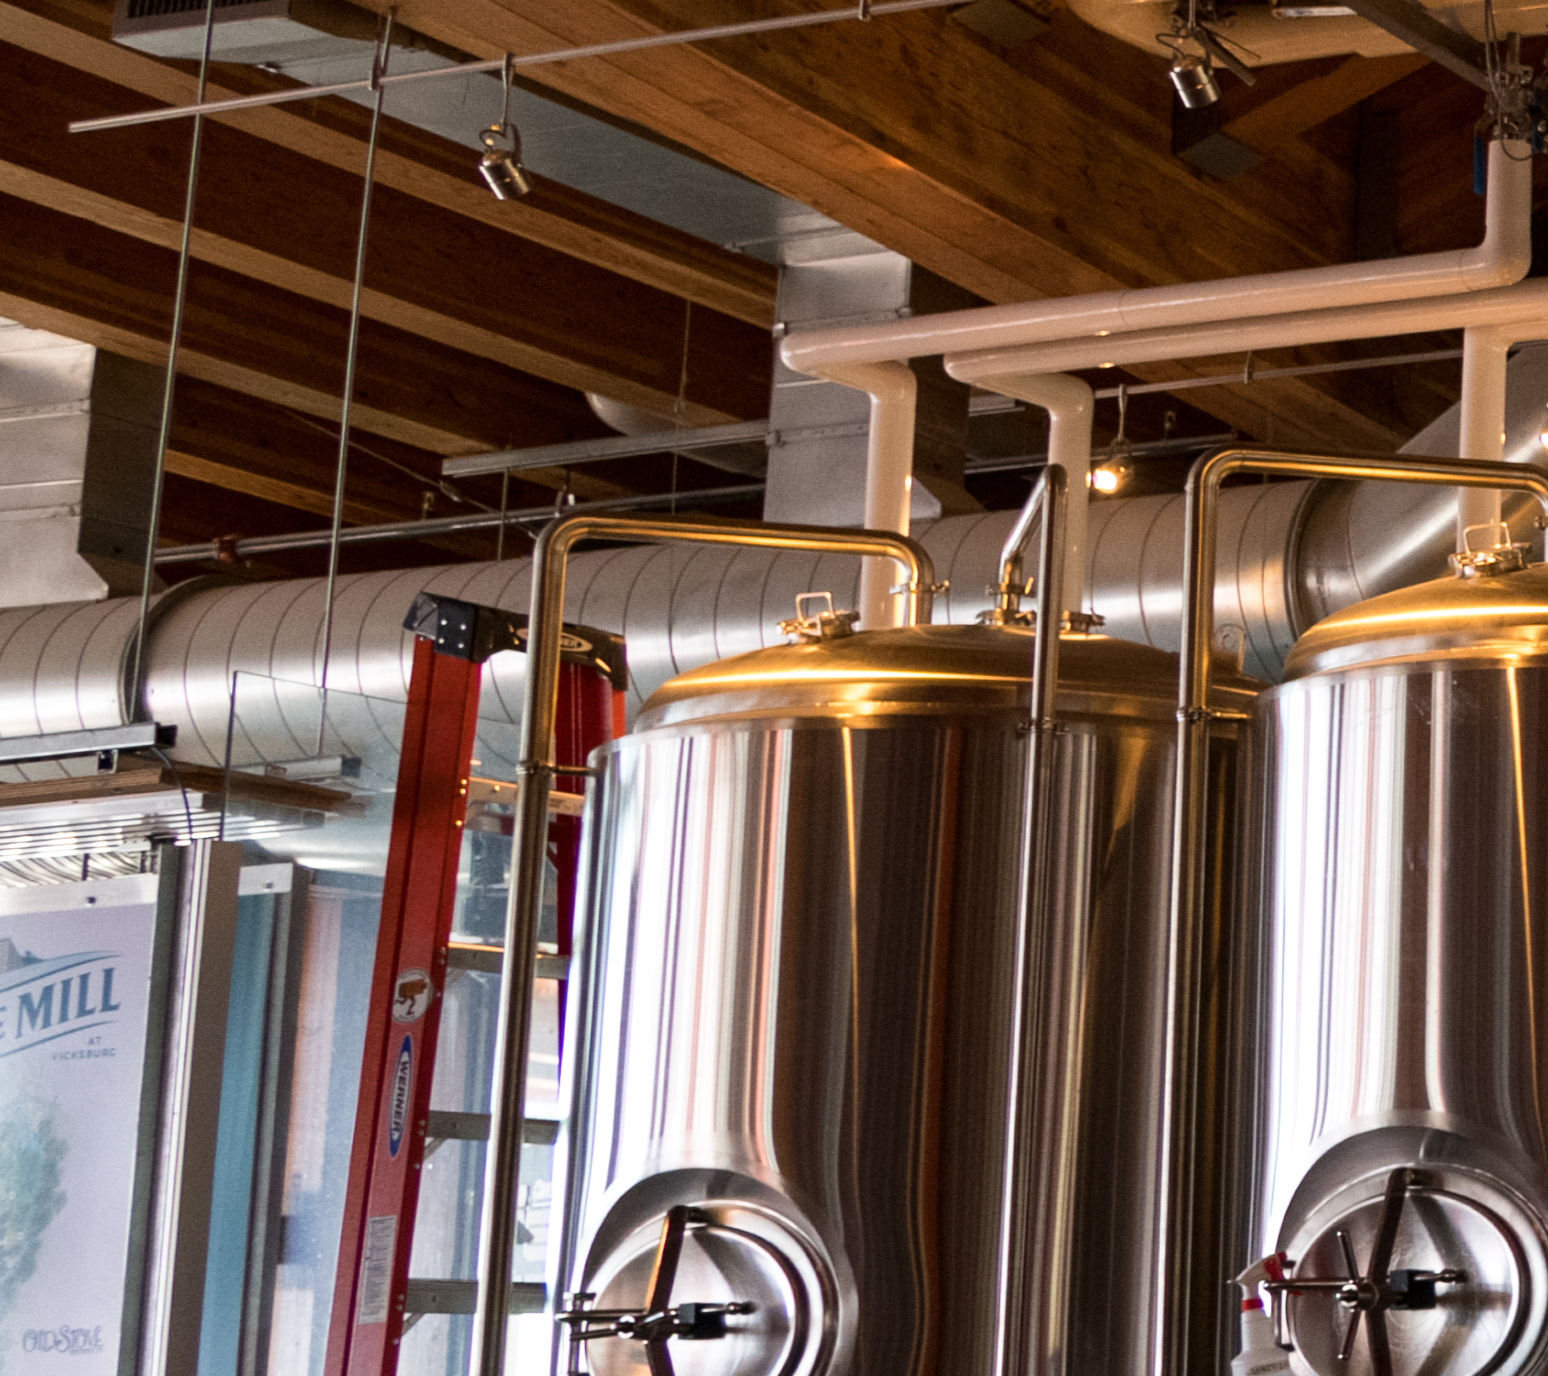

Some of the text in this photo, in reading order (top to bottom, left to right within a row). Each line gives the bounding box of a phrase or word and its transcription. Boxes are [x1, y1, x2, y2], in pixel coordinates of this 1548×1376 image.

[16, 967, 122, 1039] MILL
[52, 1048, 117, 1061] VICKSBURG
[88, 1036, 102, 1046] AT
[391, 1060, 409, 1136] WERNER
